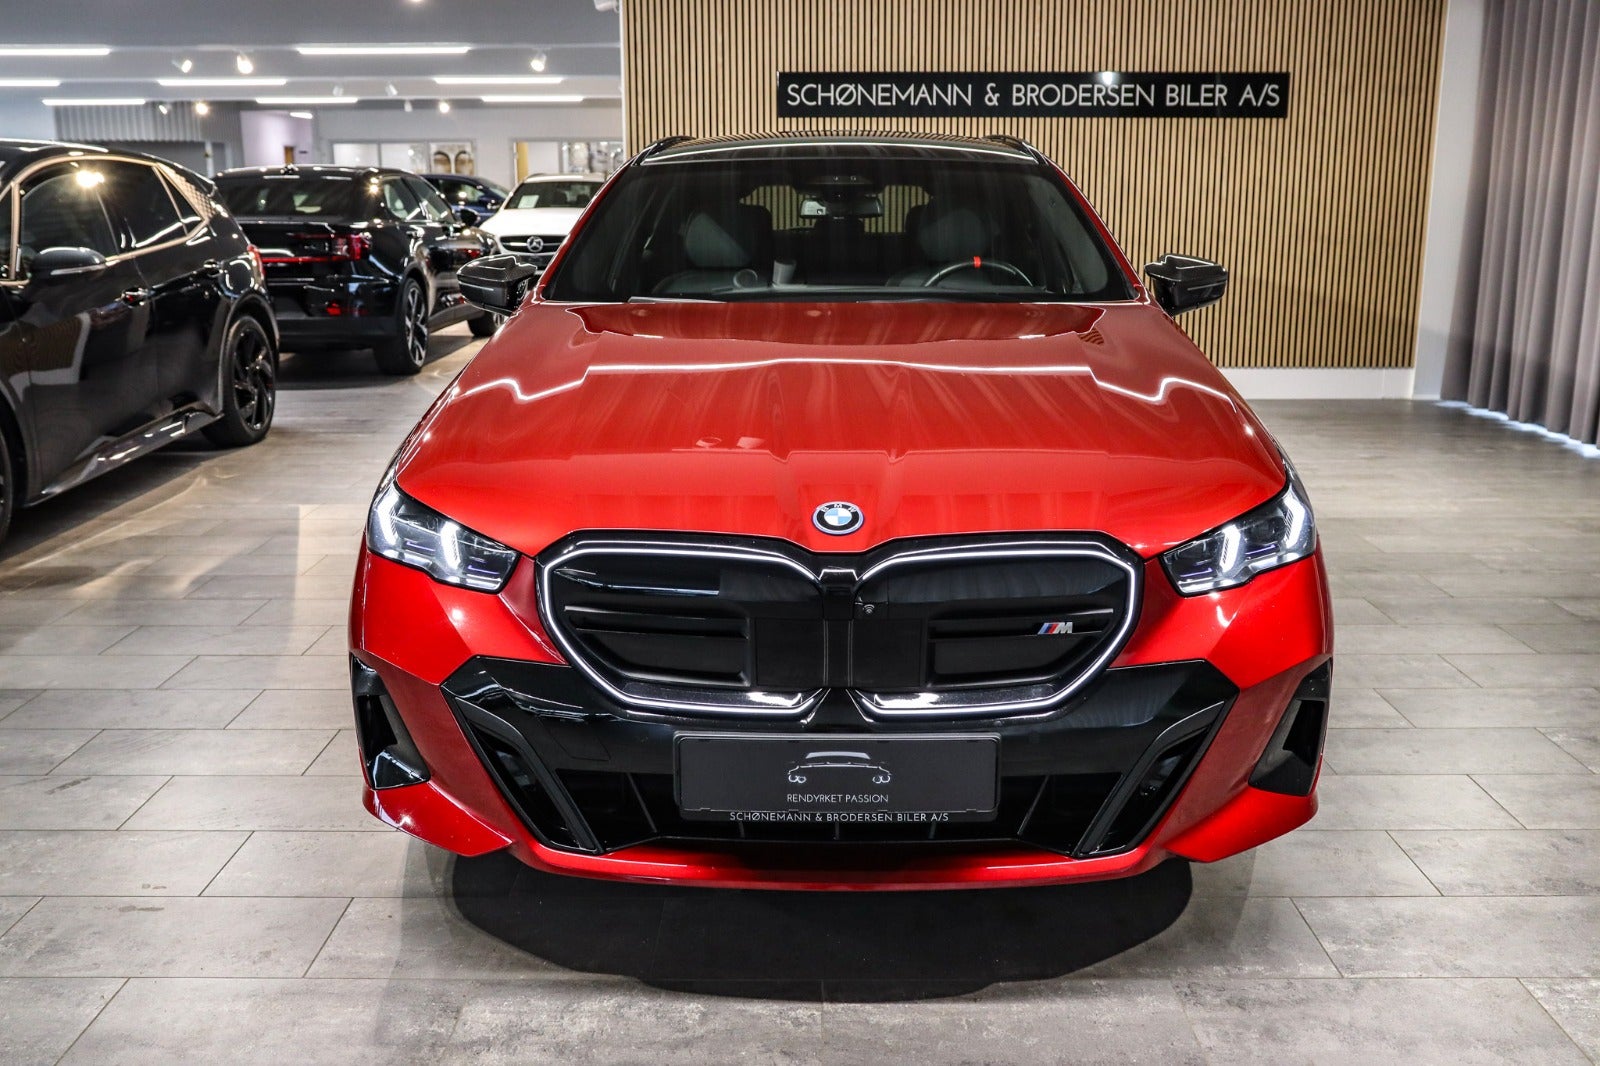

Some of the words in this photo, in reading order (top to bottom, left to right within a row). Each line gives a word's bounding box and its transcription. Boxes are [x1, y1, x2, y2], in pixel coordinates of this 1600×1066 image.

[787, 83, 972, 106] SCHØNEMANN
[984, 83, 1000, 106] &
[1012, 83, 1155, 106] BRODERSEN
[1166, 84, 1228, 106] BILER
[1238, 83, 1280, 107] A/S
[820, 503, 858, 513] BMW
[786, 793, 843, 803] RENDYRKET
[845, 794, 889, 803] PASSION
[729, 812, 811, 822] SCHØNEMANN
[815, 812, 823, 822] &
[826, 812, 893, 822] BRODERSEN
[896, 812, 927, 822] BILER
[930, 812, 949, 822] A/S
